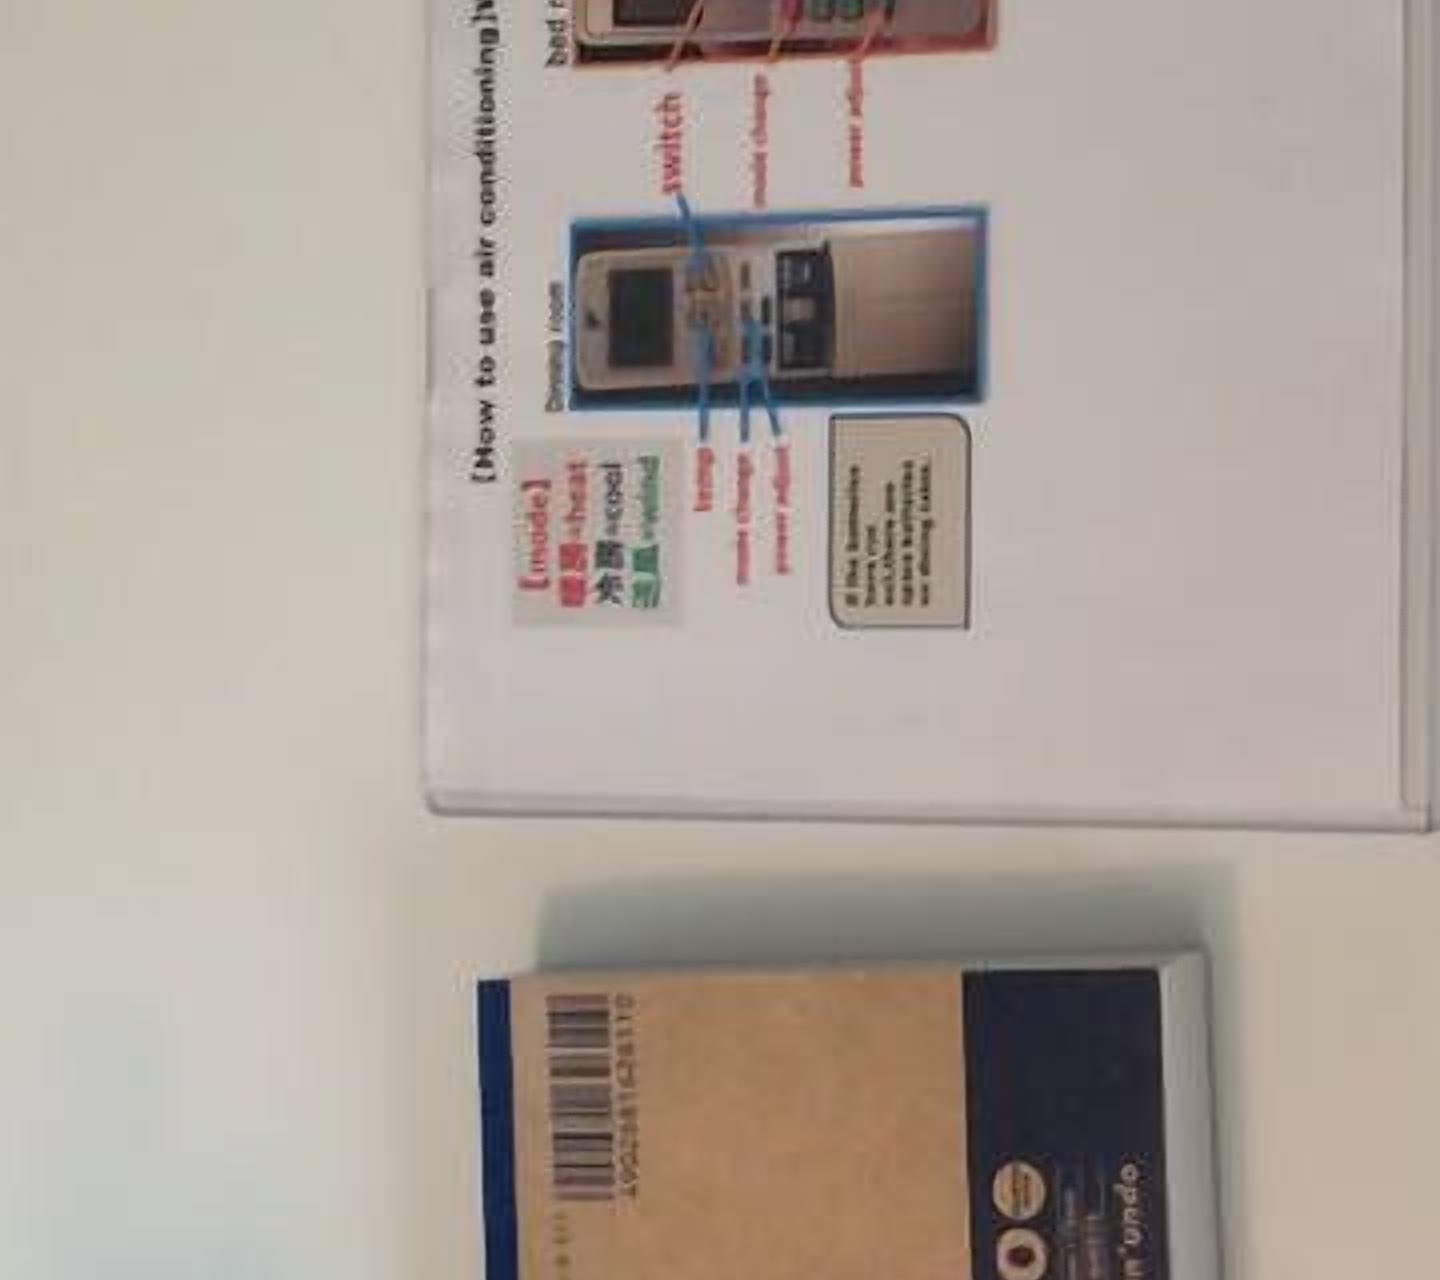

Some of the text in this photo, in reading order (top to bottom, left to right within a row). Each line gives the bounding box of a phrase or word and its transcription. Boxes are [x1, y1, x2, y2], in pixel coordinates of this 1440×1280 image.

[545, 19, 569, 69] bed
[652, 93, 684, 196] switch
[472, 239, 495, 278] air
[478, 288, 496, 345] use
[472, 355, 495, 387] to
[693, 446, 715, 512] temp
